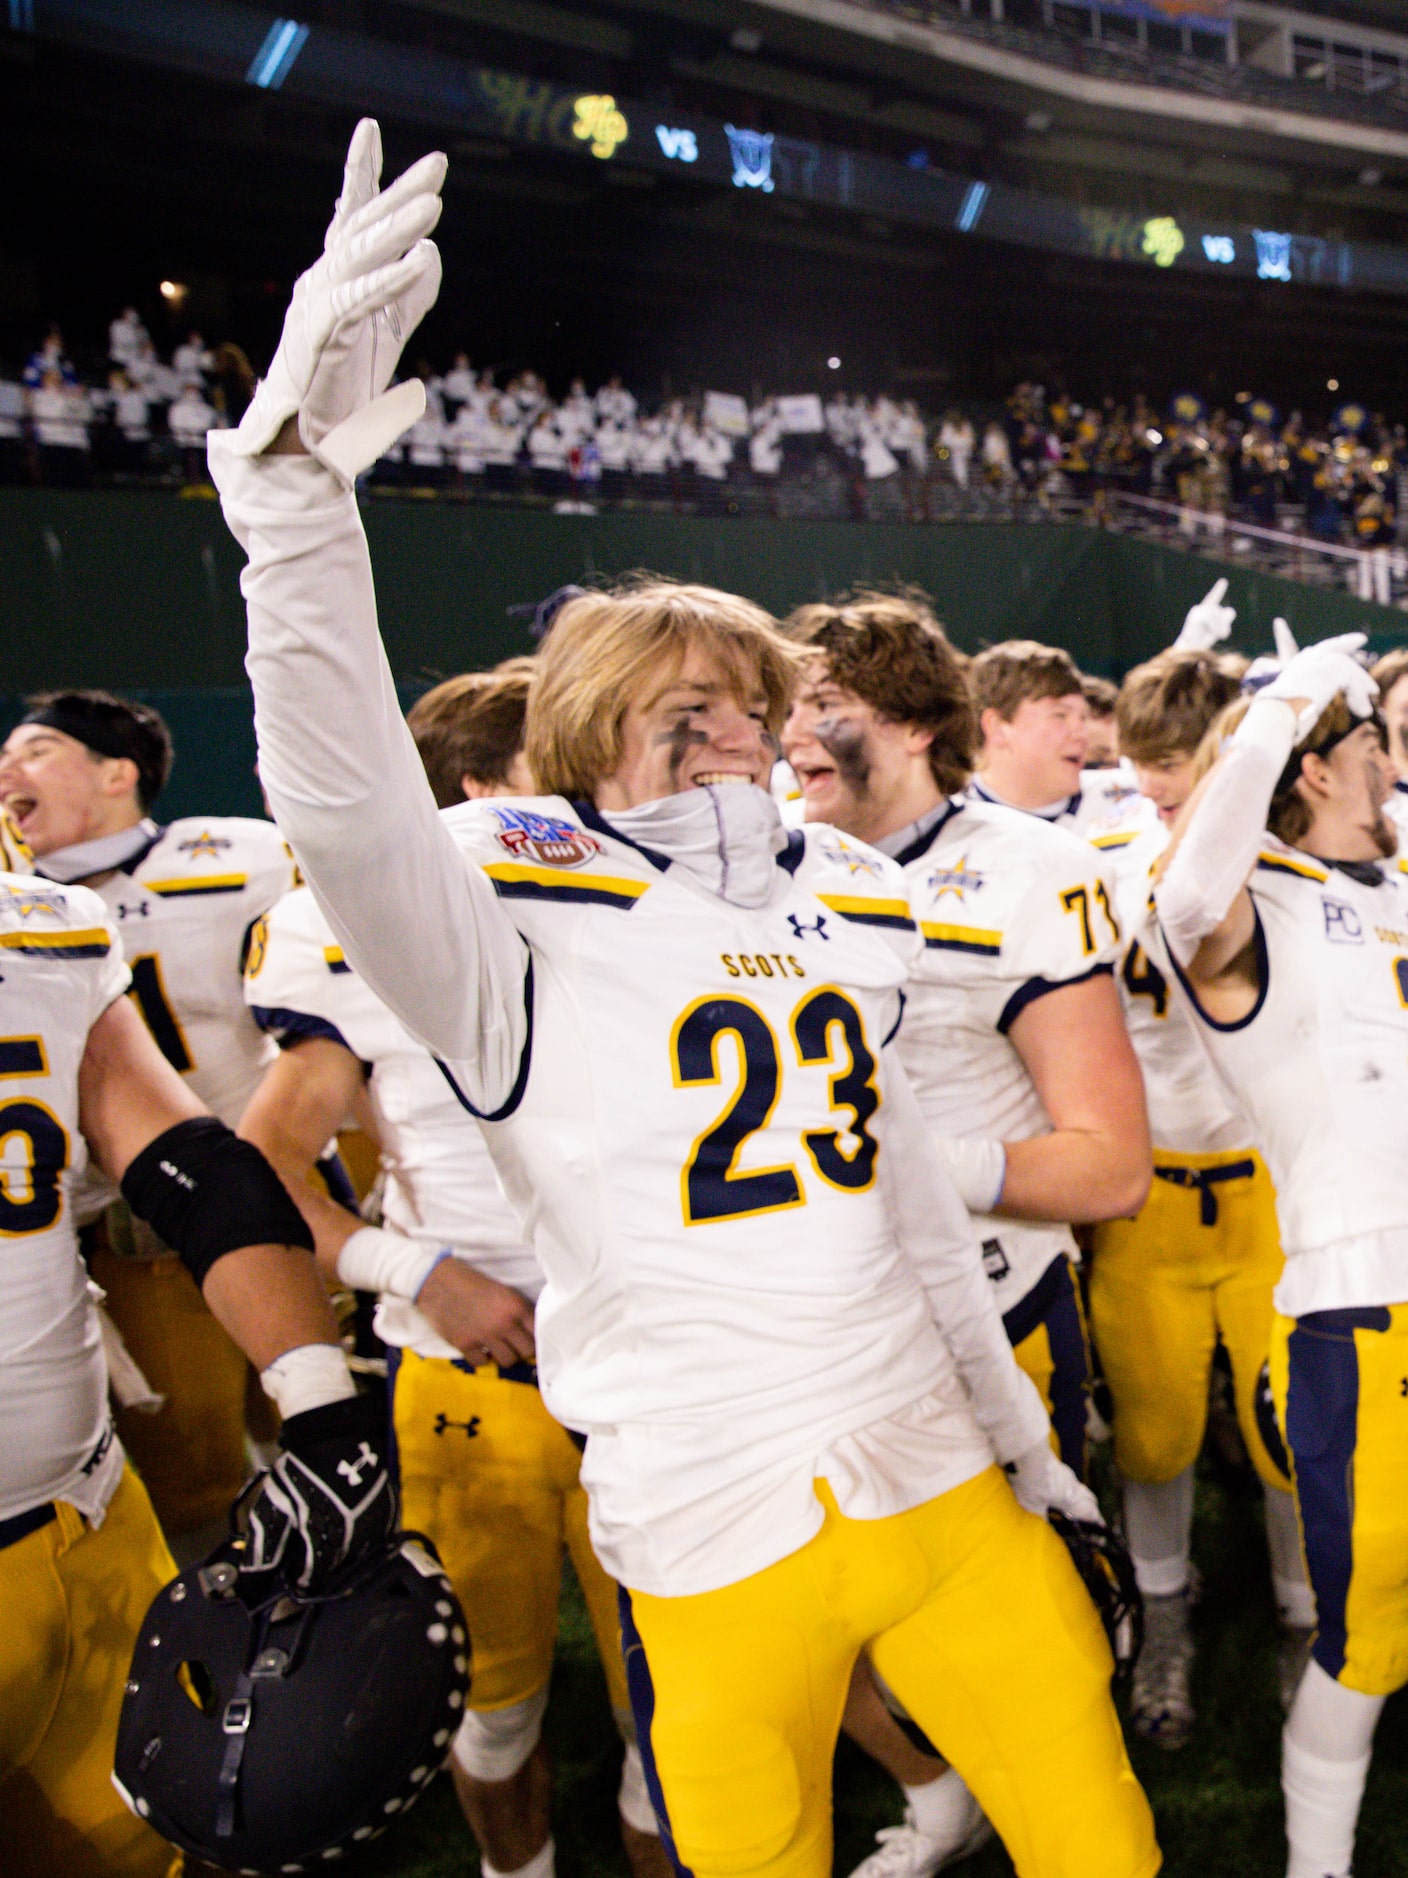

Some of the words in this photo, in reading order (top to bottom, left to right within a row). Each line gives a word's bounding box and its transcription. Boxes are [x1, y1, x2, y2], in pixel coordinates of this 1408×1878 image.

[1058, 877, 1120, 957] 71
[720, 952, 807, 979] SCOTS
[667, 982, 883, 1228] 23
